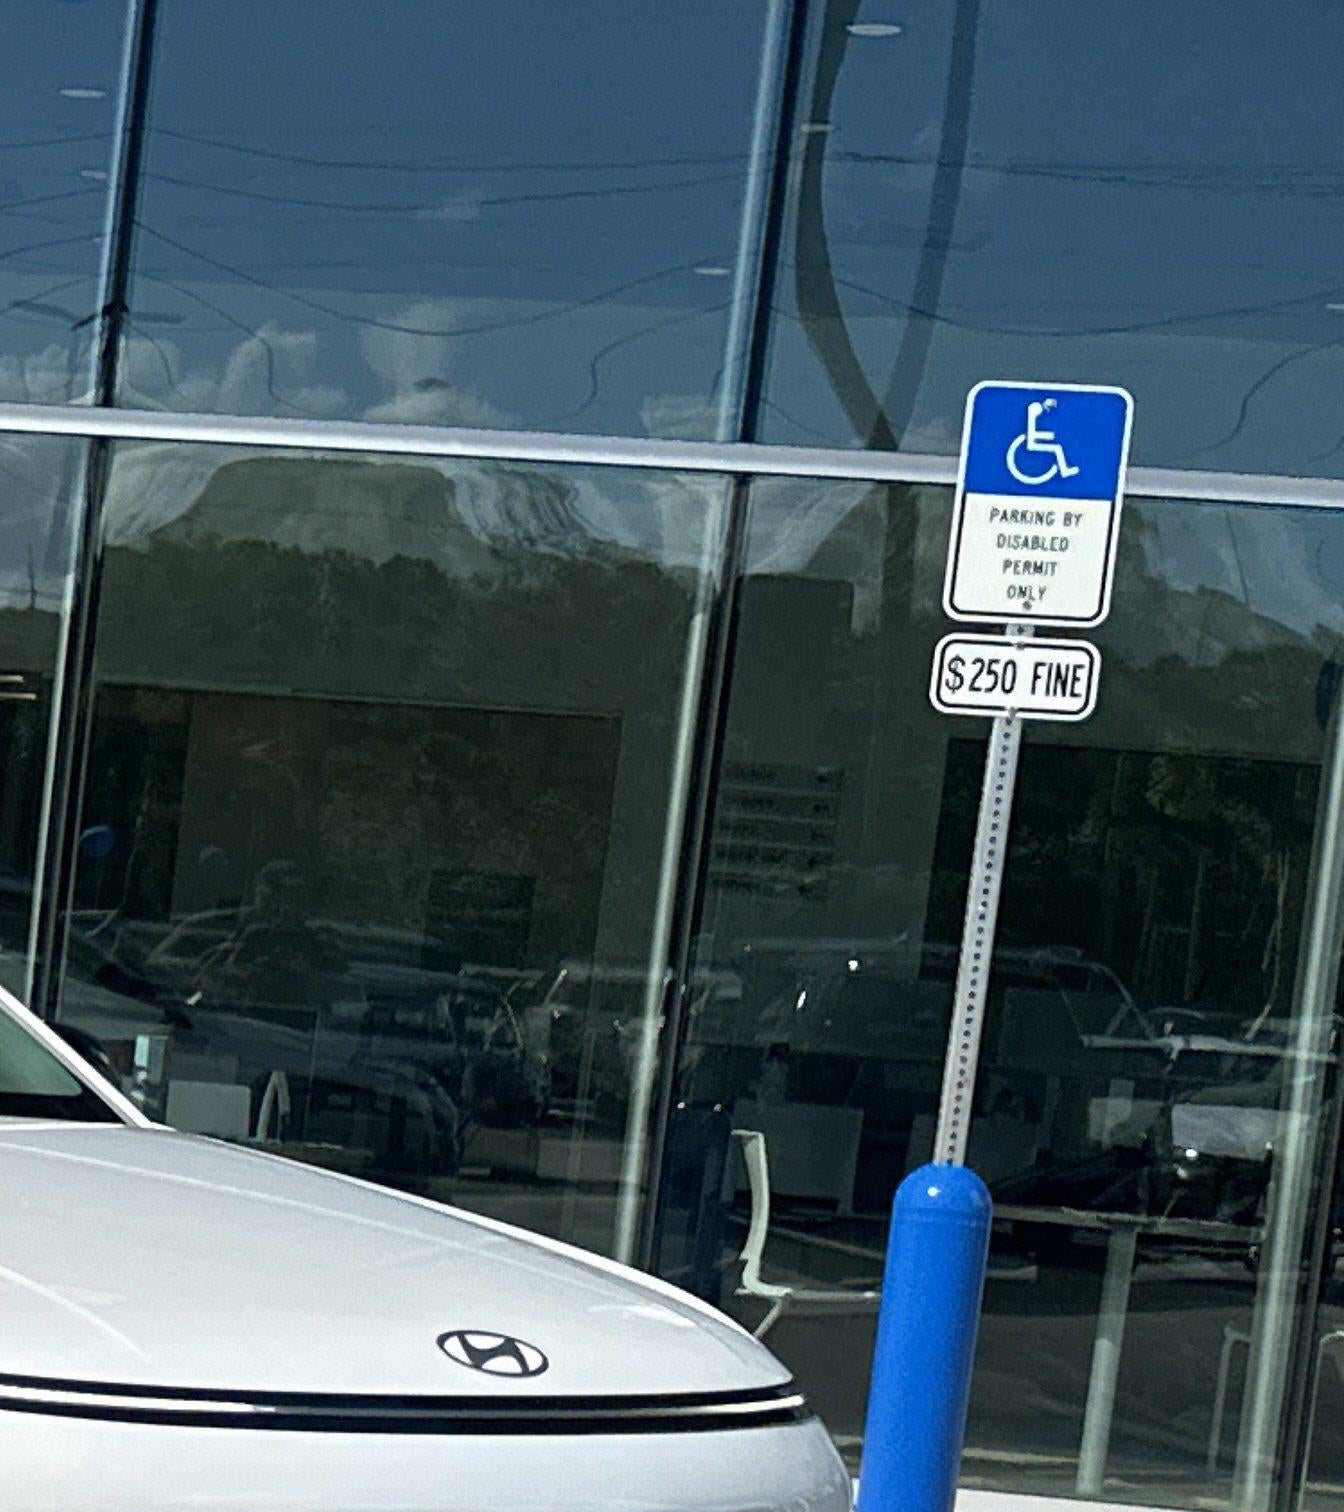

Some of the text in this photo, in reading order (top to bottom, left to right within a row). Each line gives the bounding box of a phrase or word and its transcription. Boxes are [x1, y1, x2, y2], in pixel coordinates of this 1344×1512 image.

[989, 506, 1083, 527] PARKING BY
[996, 532, 1069, 552] DISABLED
[1002, 558, 1058, 577] PERMIT
[1006, 584, 1048, 602] ONLY
[945, 654, 1086, 698] $250 FINE
